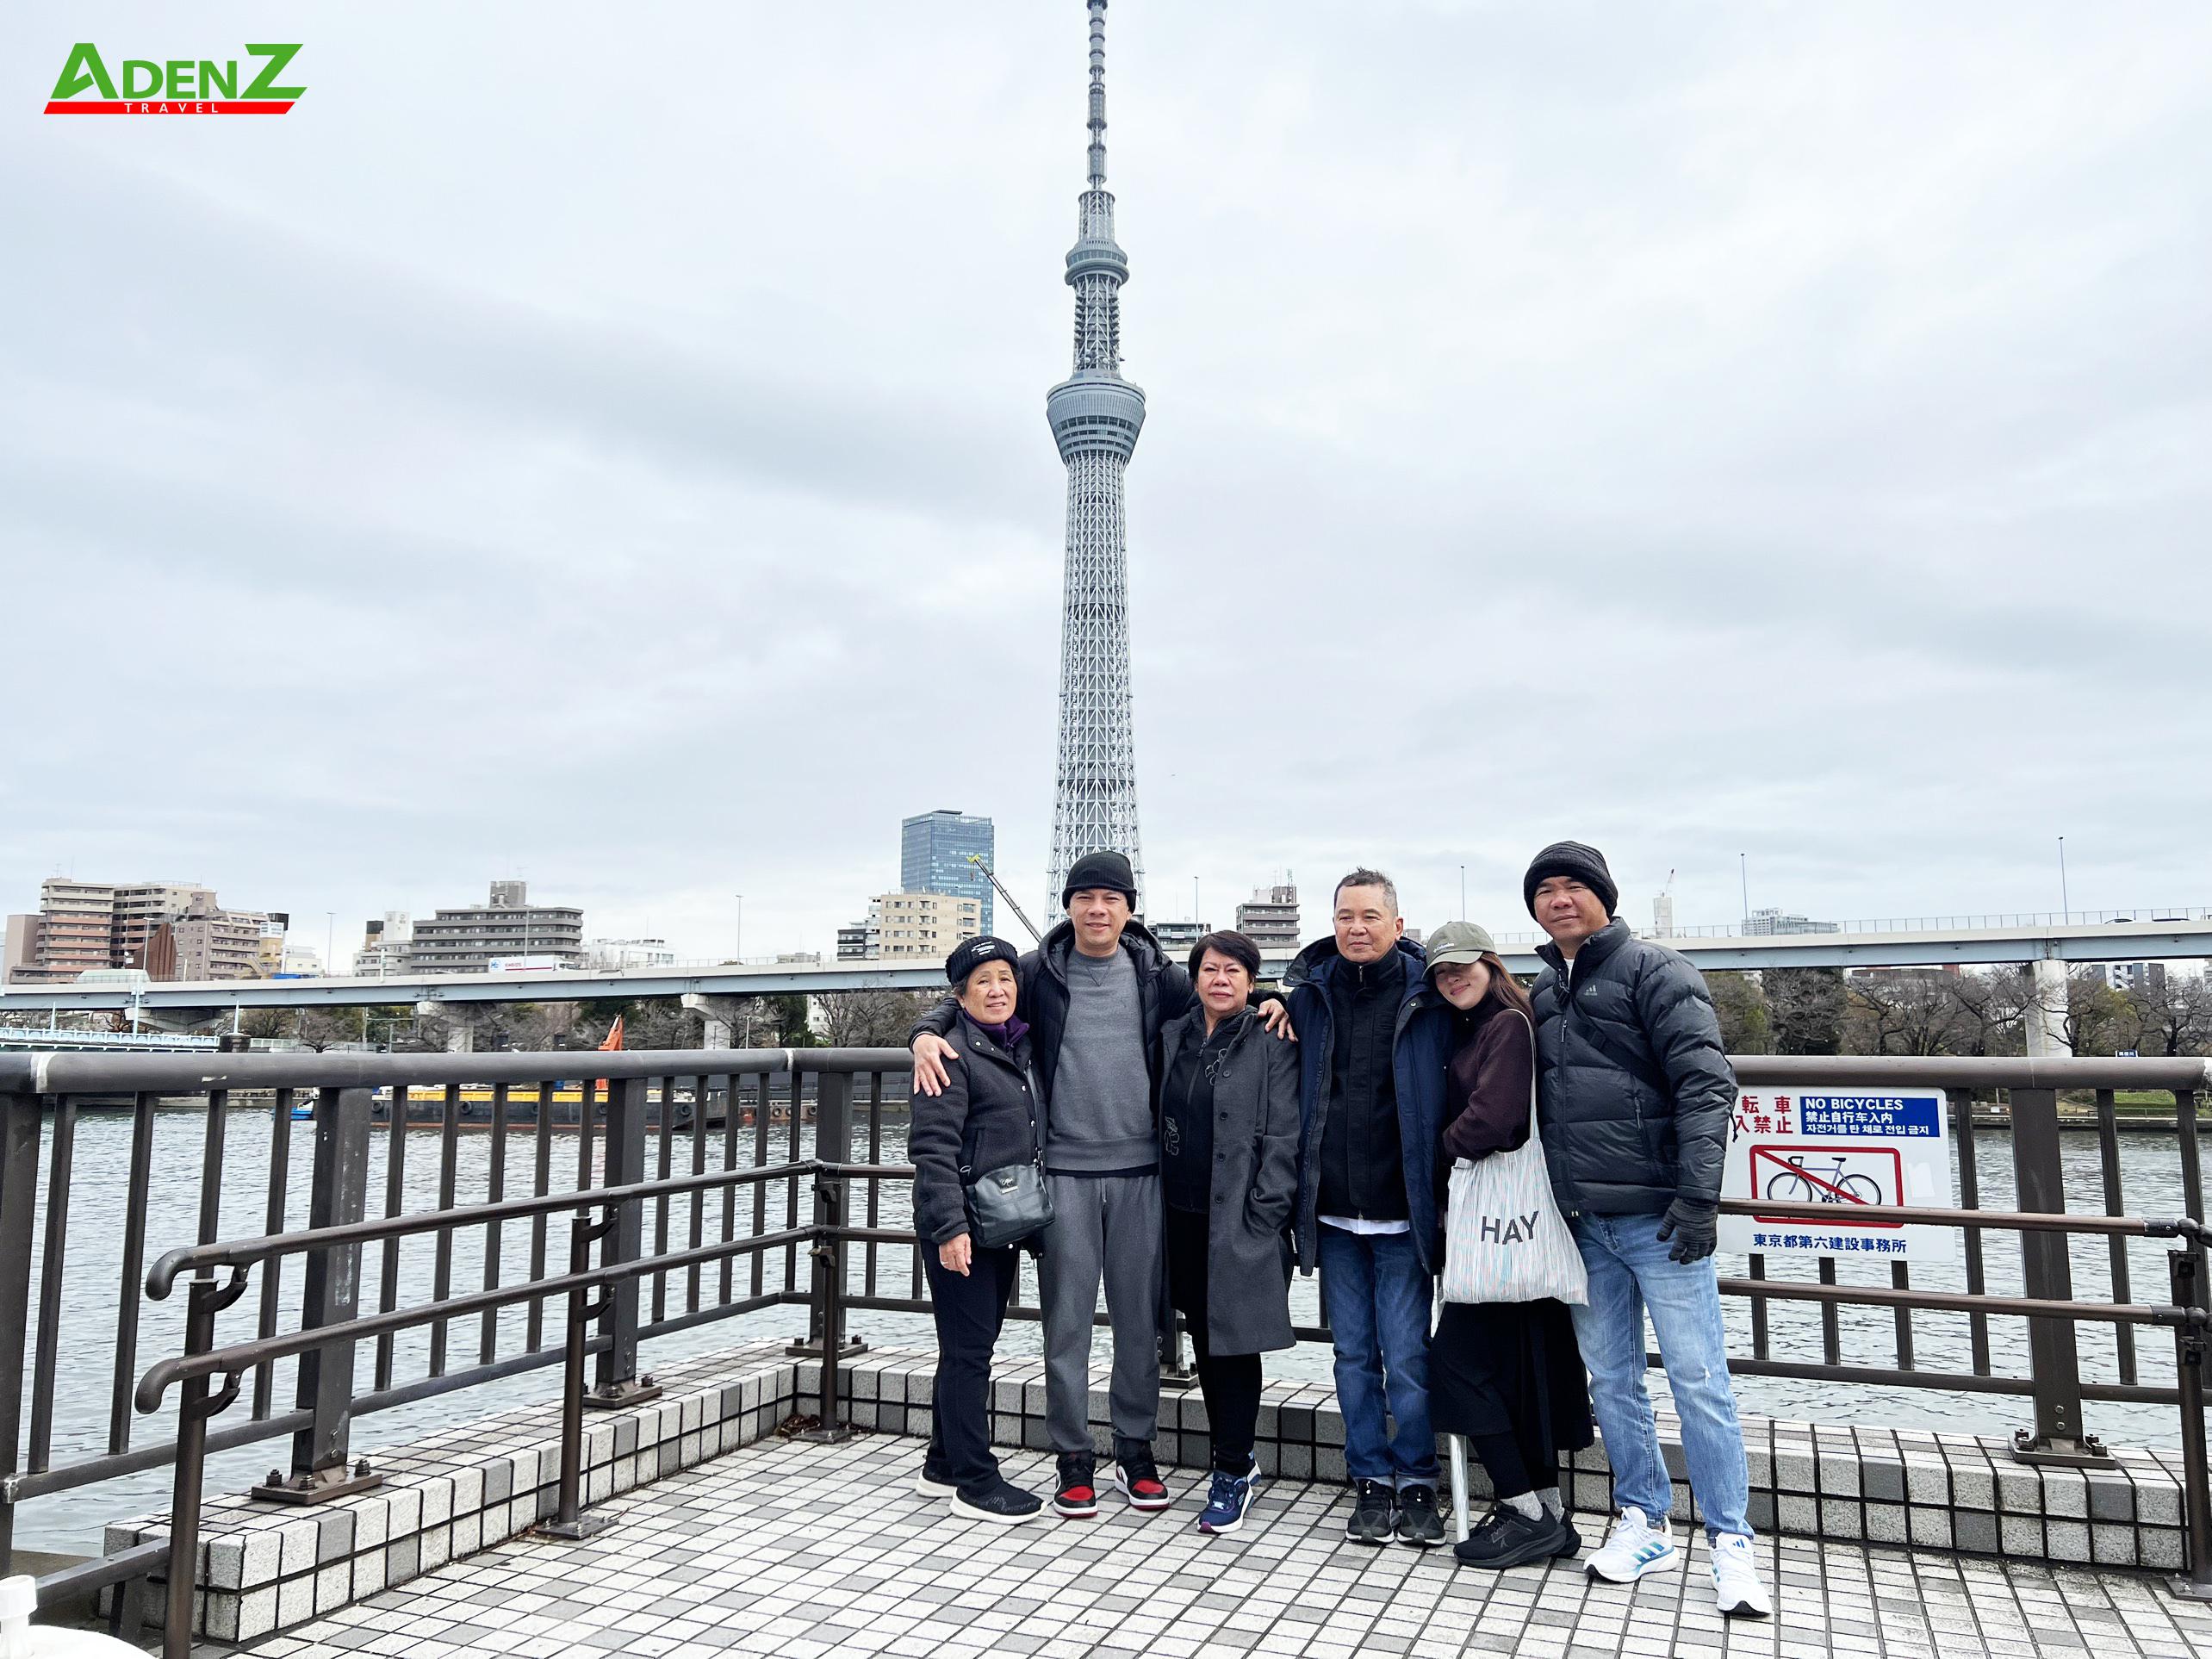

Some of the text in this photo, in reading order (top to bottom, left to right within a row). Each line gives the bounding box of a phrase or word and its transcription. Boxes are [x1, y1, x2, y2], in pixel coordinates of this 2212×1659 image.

[1805, 1098, 1904, 1110] NO BICYCLES
[1805, 1111, 1893, 1124] 禁止自行车入内
[1806, 1124, 1848, 1134] 자전거를
[1908, 1125, 1929, 1135] 금지
[1481, 1210, 1539, 1246] HAY
[1753, 1233, 1907, 1253] 東京都第六建設事務所
